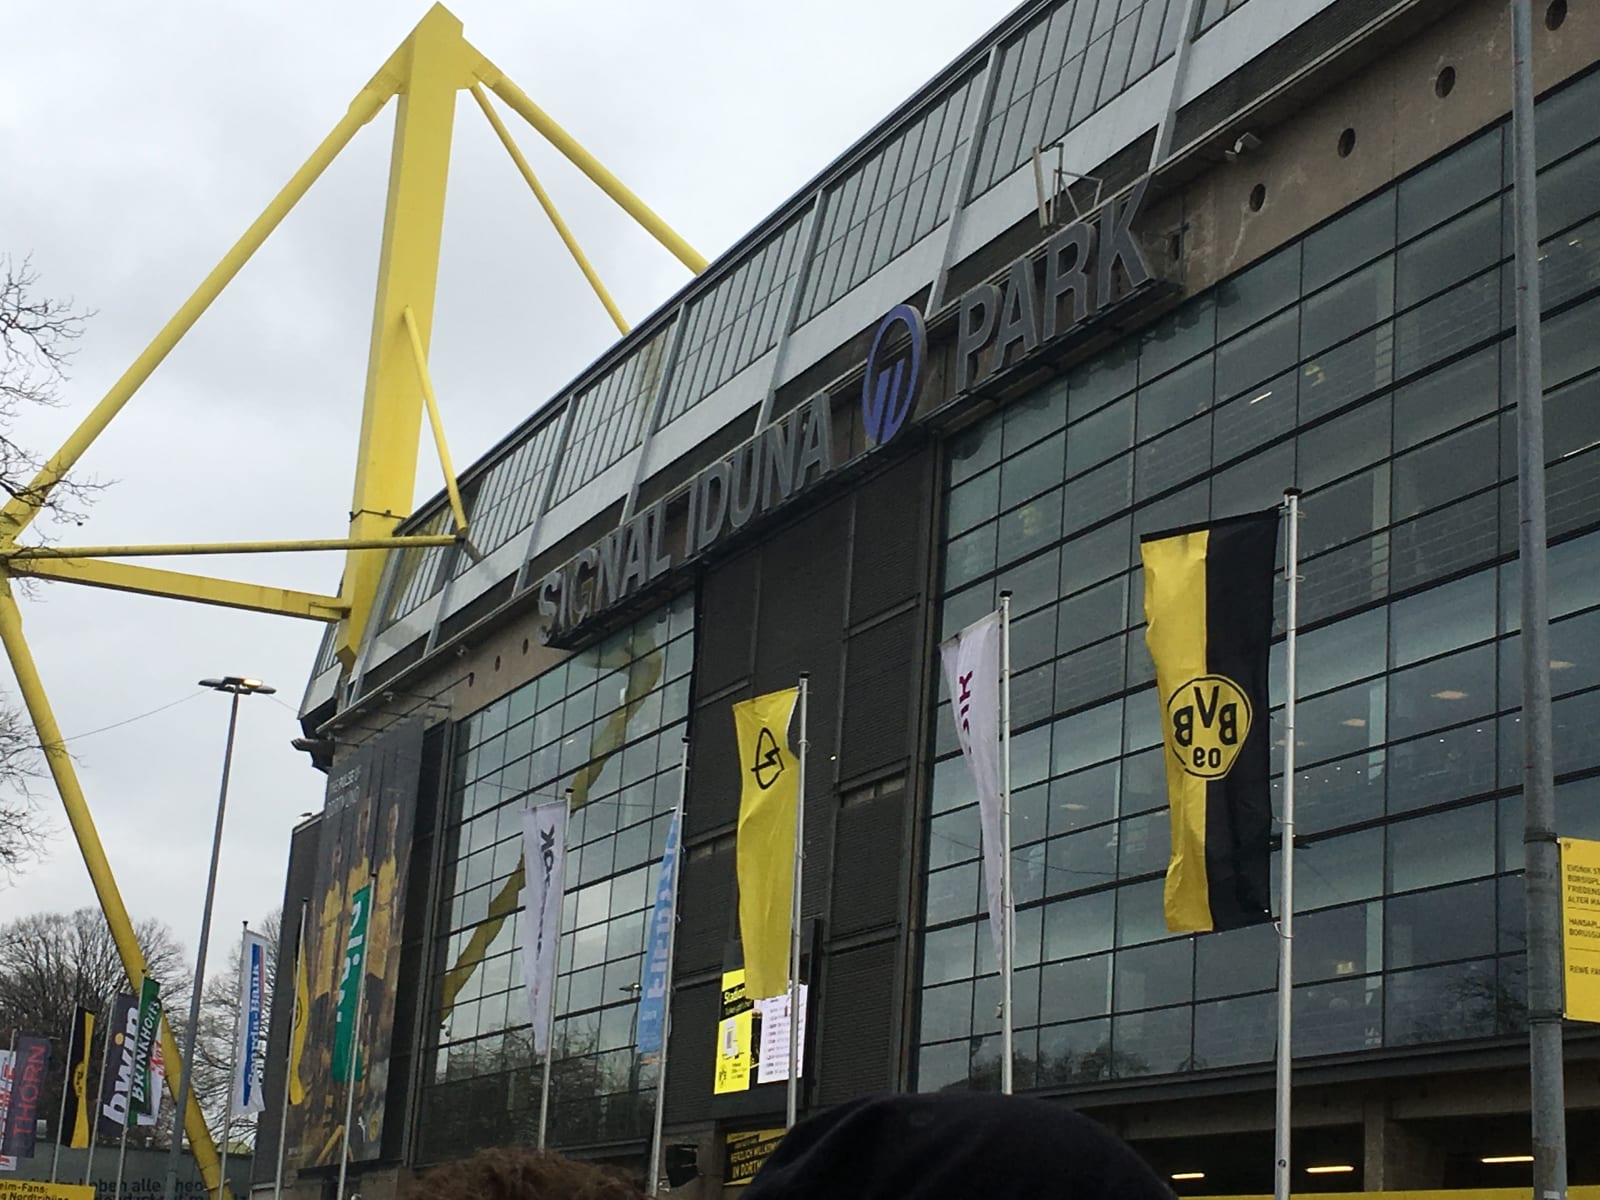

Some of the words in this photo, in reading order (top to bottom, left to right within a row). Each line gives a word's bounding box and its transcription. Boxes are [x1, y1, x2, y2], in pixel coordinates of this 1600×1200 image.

[537, 500, 672, 646] SIGNAL
[684, 391, 834, 559] IDUNA
[956, 178, 1150, 394] PARK
[13, 1045, 47, 1137] THORN
[103, 1006, 139, 1125] bwin
[132, 1178, 160, 1193] alle
